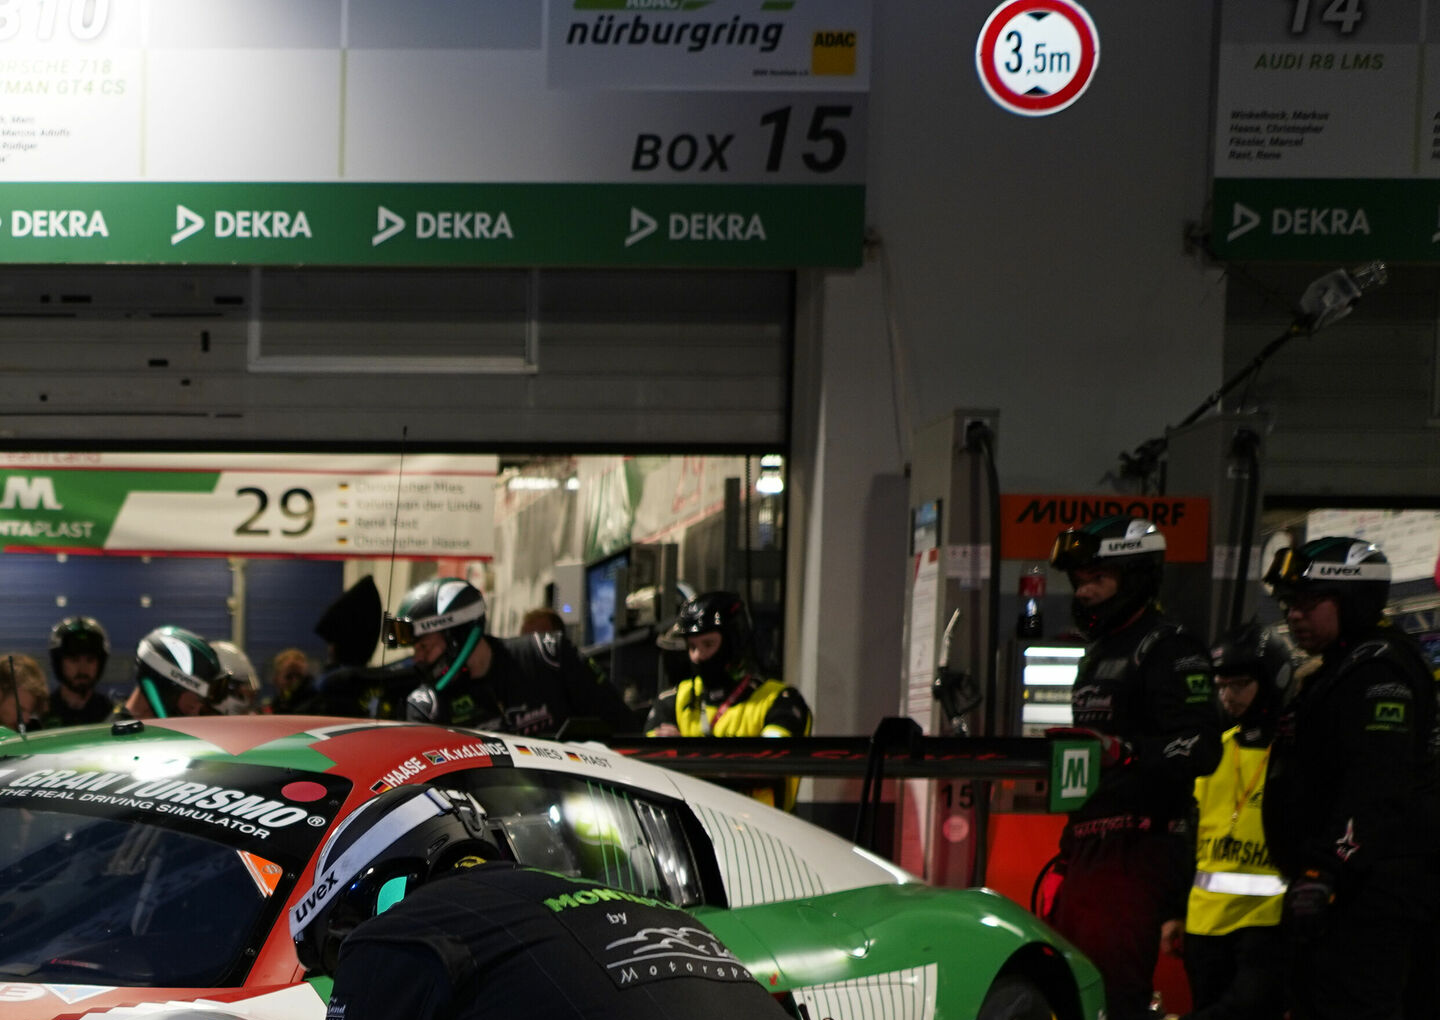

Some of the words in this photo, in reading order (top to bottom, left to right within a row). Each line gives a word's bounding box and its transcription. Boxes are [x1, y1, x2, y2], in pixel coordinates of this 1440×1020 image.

[566, 15, 784, 53] nürburgring
[813, 32, 856, 48] ADAC
[1255, 54, 1302, 70] AUDI
[1309, 54, 1333, 70] R8
[1341, 53, 1384, 69] LMS
[56, 79, 95, 95] GT4
[101, 79, 127, 95] CS
[631, 134, 735, 173] BOX
[760, 104, 853, 174] 15
[11, 210, 109, 237] DEKRA
[214, 211, 312, 238] DEKRA
[416, 211, 513, 239] DEKRA
[668, 212, 766, 241] DEKRA
[1271, 207, 1371, 236] DEKRA
[233, 486, 316, 538] 29
[1107, 538, 1143, 551] uvex
[1320, 566, 1362, 576] uvex
[531, 745, 563, 761] MIES
[580, 753, 612, 768] RAST
[7, 768, 113, 792] GRAN
[383, 756, 427, 788] HAASE
[32, 789, 74, 802] REAL
[79, 791, 156, 812] DRIVING
[159, 803, 271, 841] SIMULATOR
[295, 869, 340, 923] uvex
[607, 911, 627, 925] by
